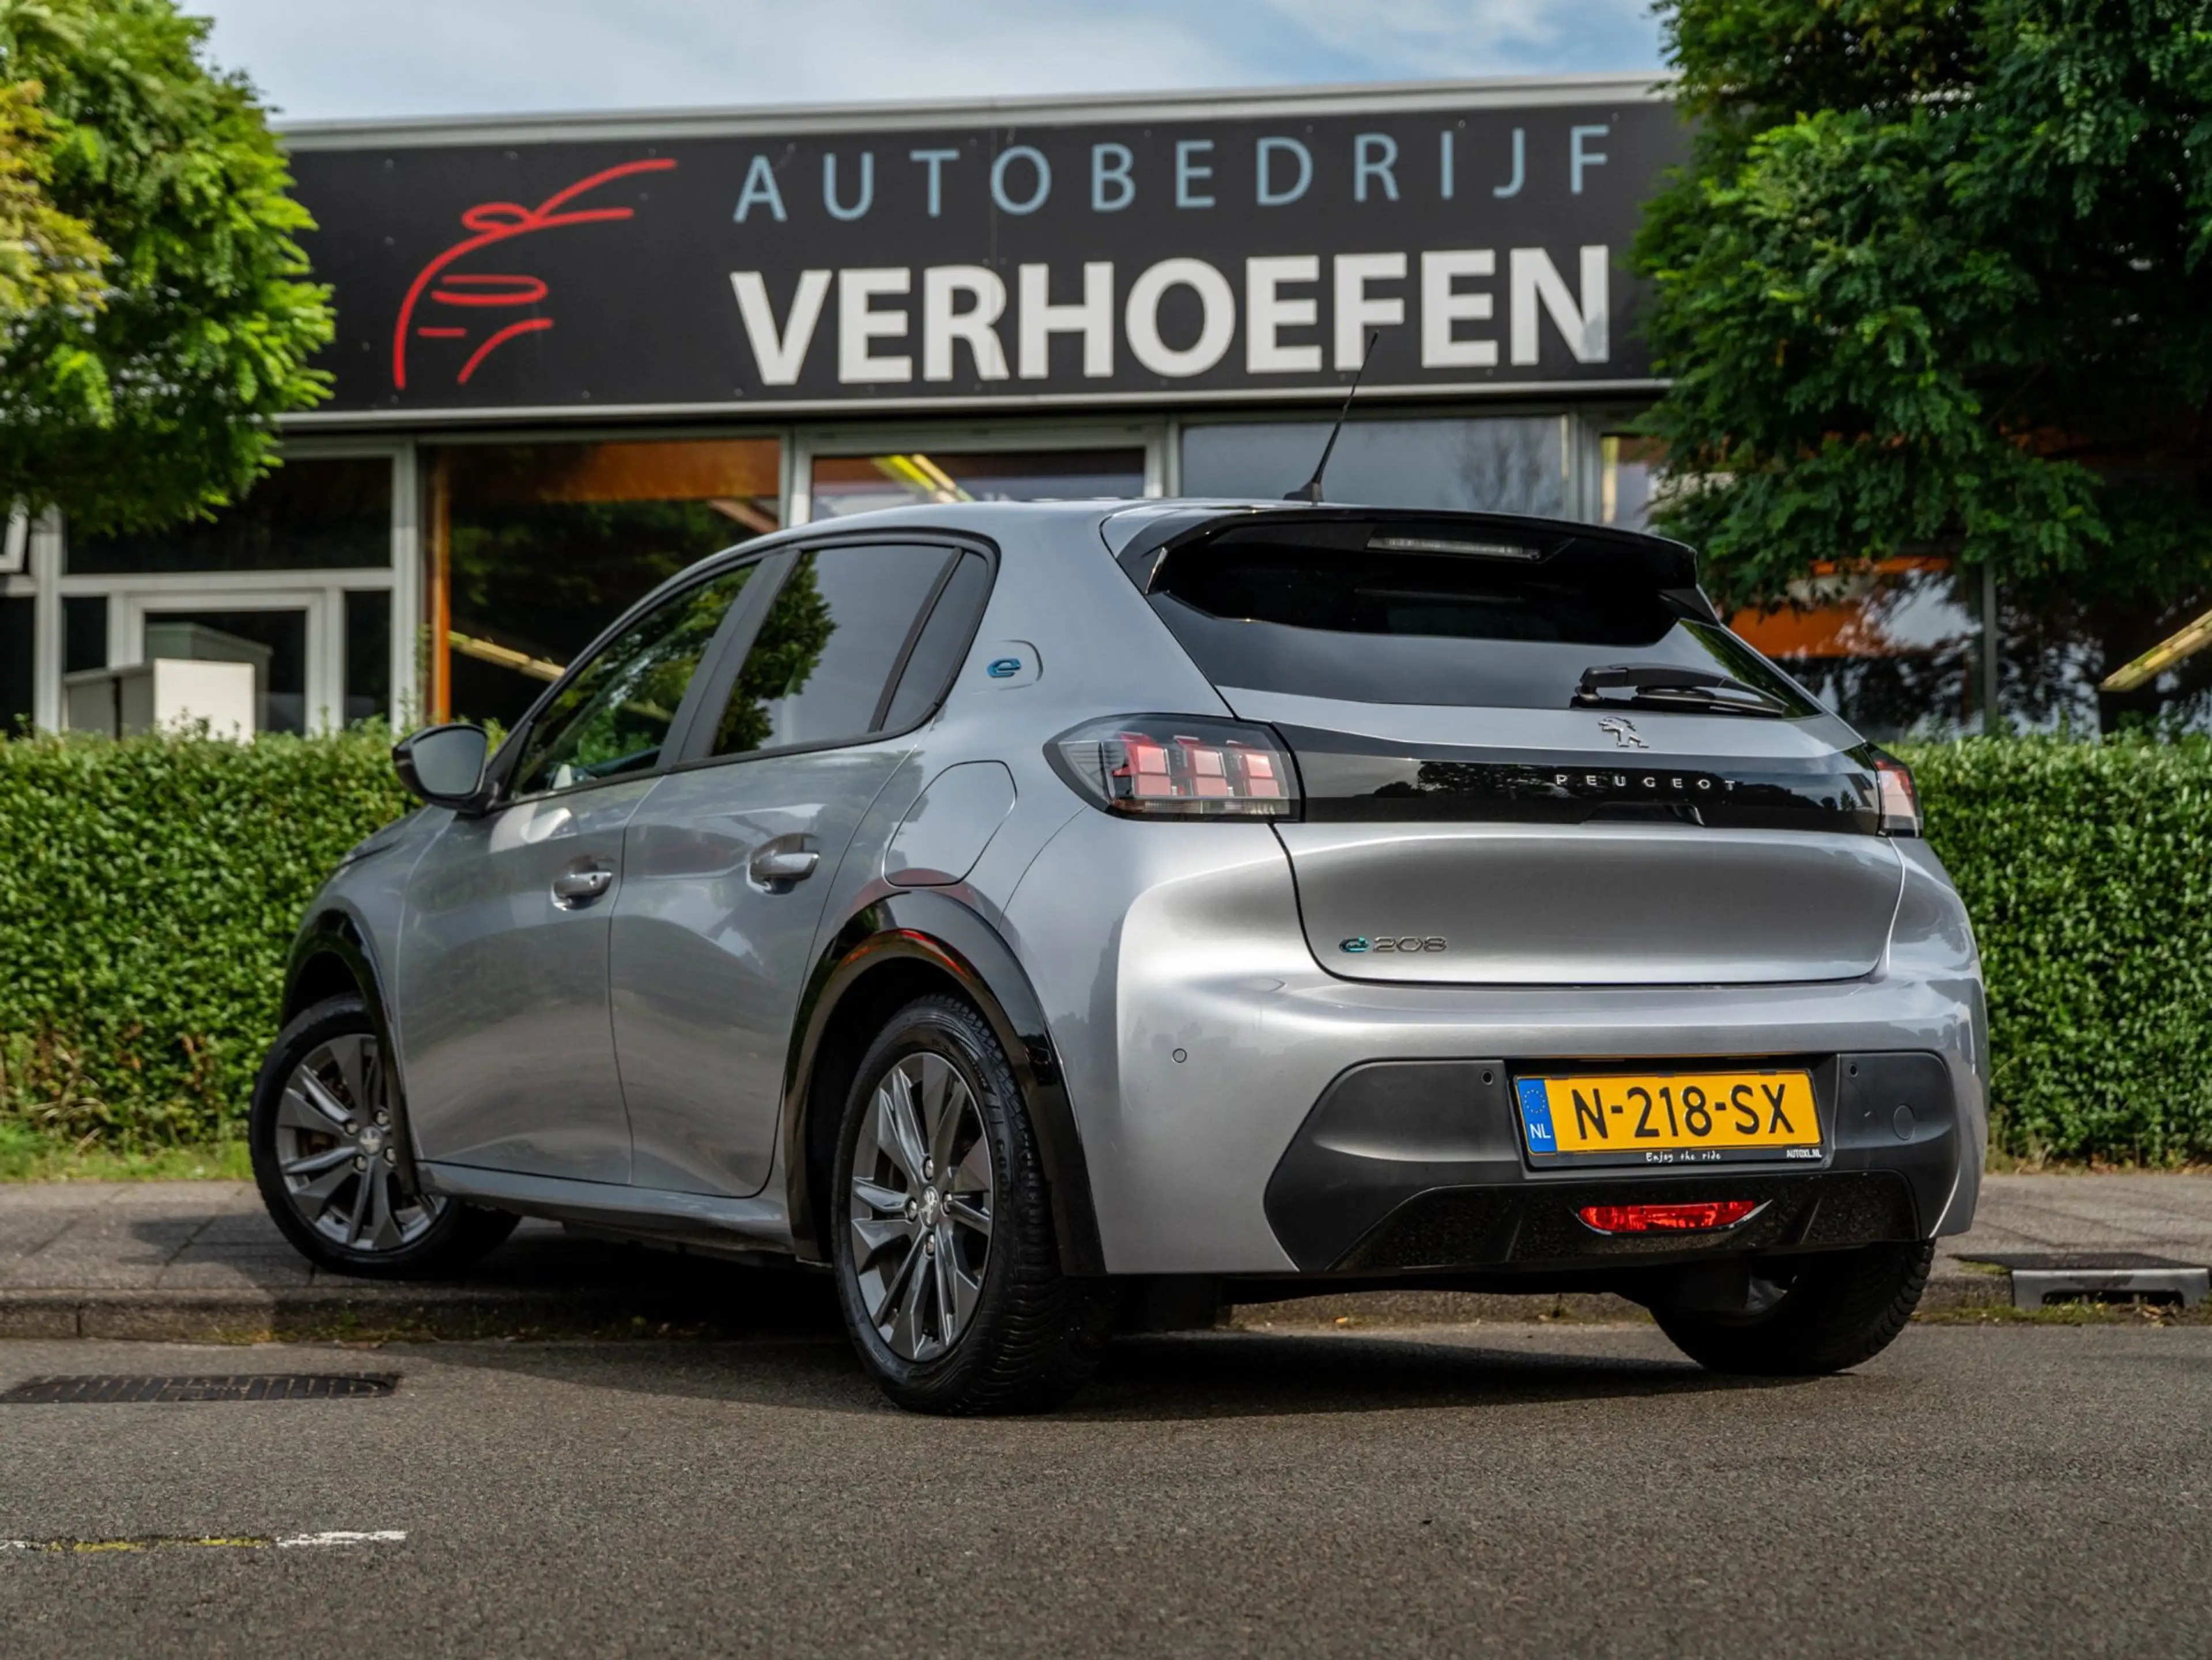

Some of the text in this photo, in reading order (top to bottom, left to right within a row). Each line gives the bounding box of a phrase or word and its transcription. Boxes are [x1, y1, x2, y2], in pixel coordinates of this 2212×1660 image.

[733, 124, 1610, 222] AUTOBEDRIJF
[729, 245, 1610, 386] VERHOEFEN
[1556, 774, 1735, 791] PEUGEOT
[1571, 1084, 1795, 1140] N-218-SX
[1530, 1123, 1551, 1140] NL
[1646, 1150, 1722, 1163] Enjoy the ride
